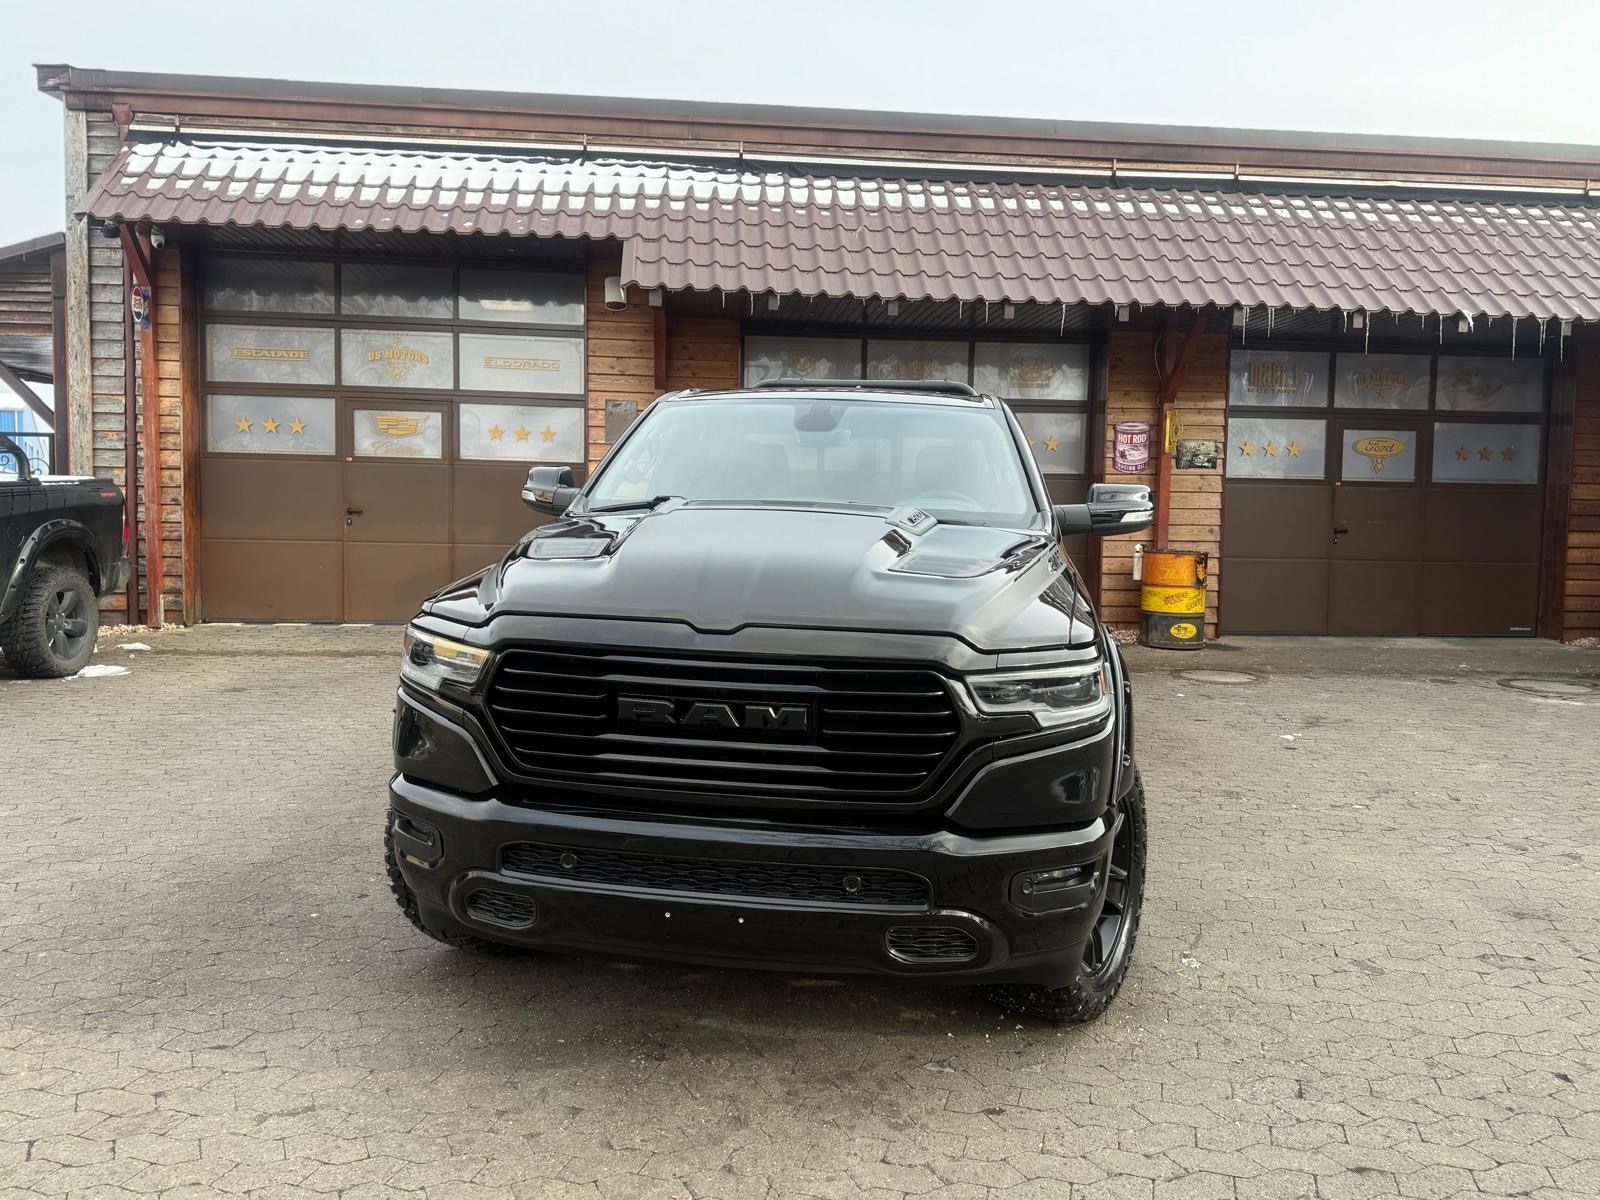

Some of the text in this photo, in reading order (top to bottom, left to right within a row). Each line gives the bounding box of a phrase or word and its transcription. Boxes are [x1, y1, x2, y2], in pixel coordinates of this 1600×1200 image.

[232, 348, 310, 360] ESCALADE
[367, 349, 429, 364] US MOTORS
[483, 358, 561, 370] ELDORADO
[1118, 433, 1147, 444] HOT ROD
[1365, 439, 1395, 452] Ford
[617, 697, 809, 731] RAM
